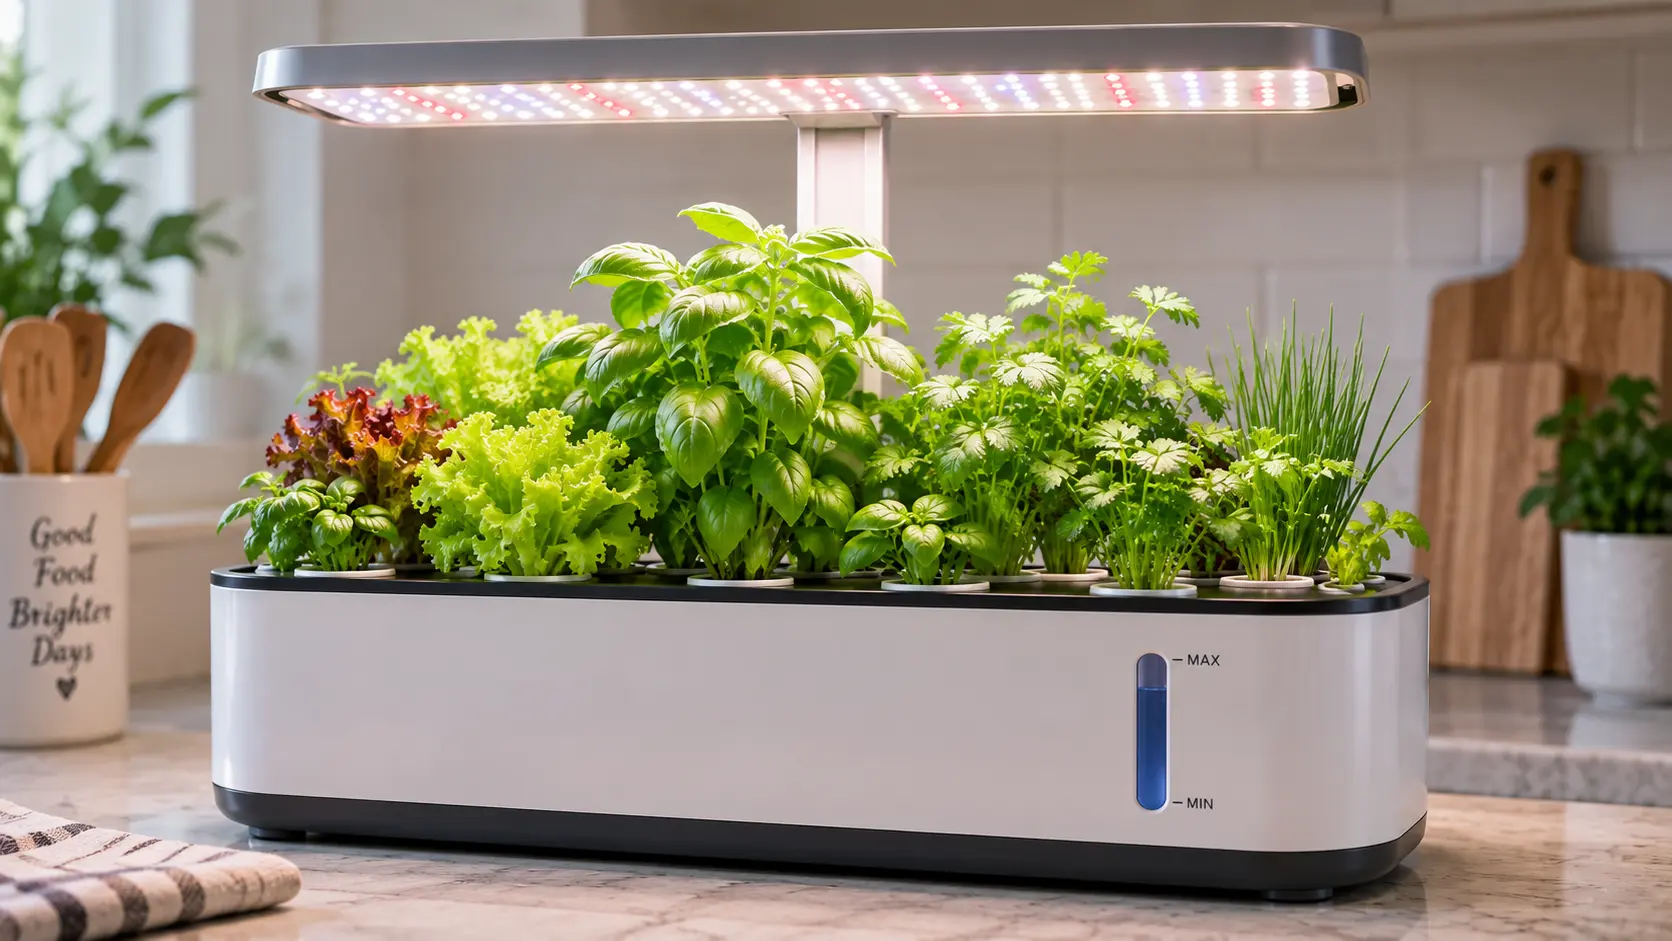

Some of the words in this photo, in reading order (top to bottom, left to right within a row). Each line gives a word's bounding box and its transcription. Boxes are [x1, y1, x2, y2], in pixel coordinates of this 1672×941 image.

[30, 512, 97, 551] Good
[33, 553, 97, 588] Food
[9, 593, 112, 640] Brighter
[31, 634, 93, 674] Days
[1187, 654, 1220, 667] MAX
[1186, 797, 1214, 810] MIN
